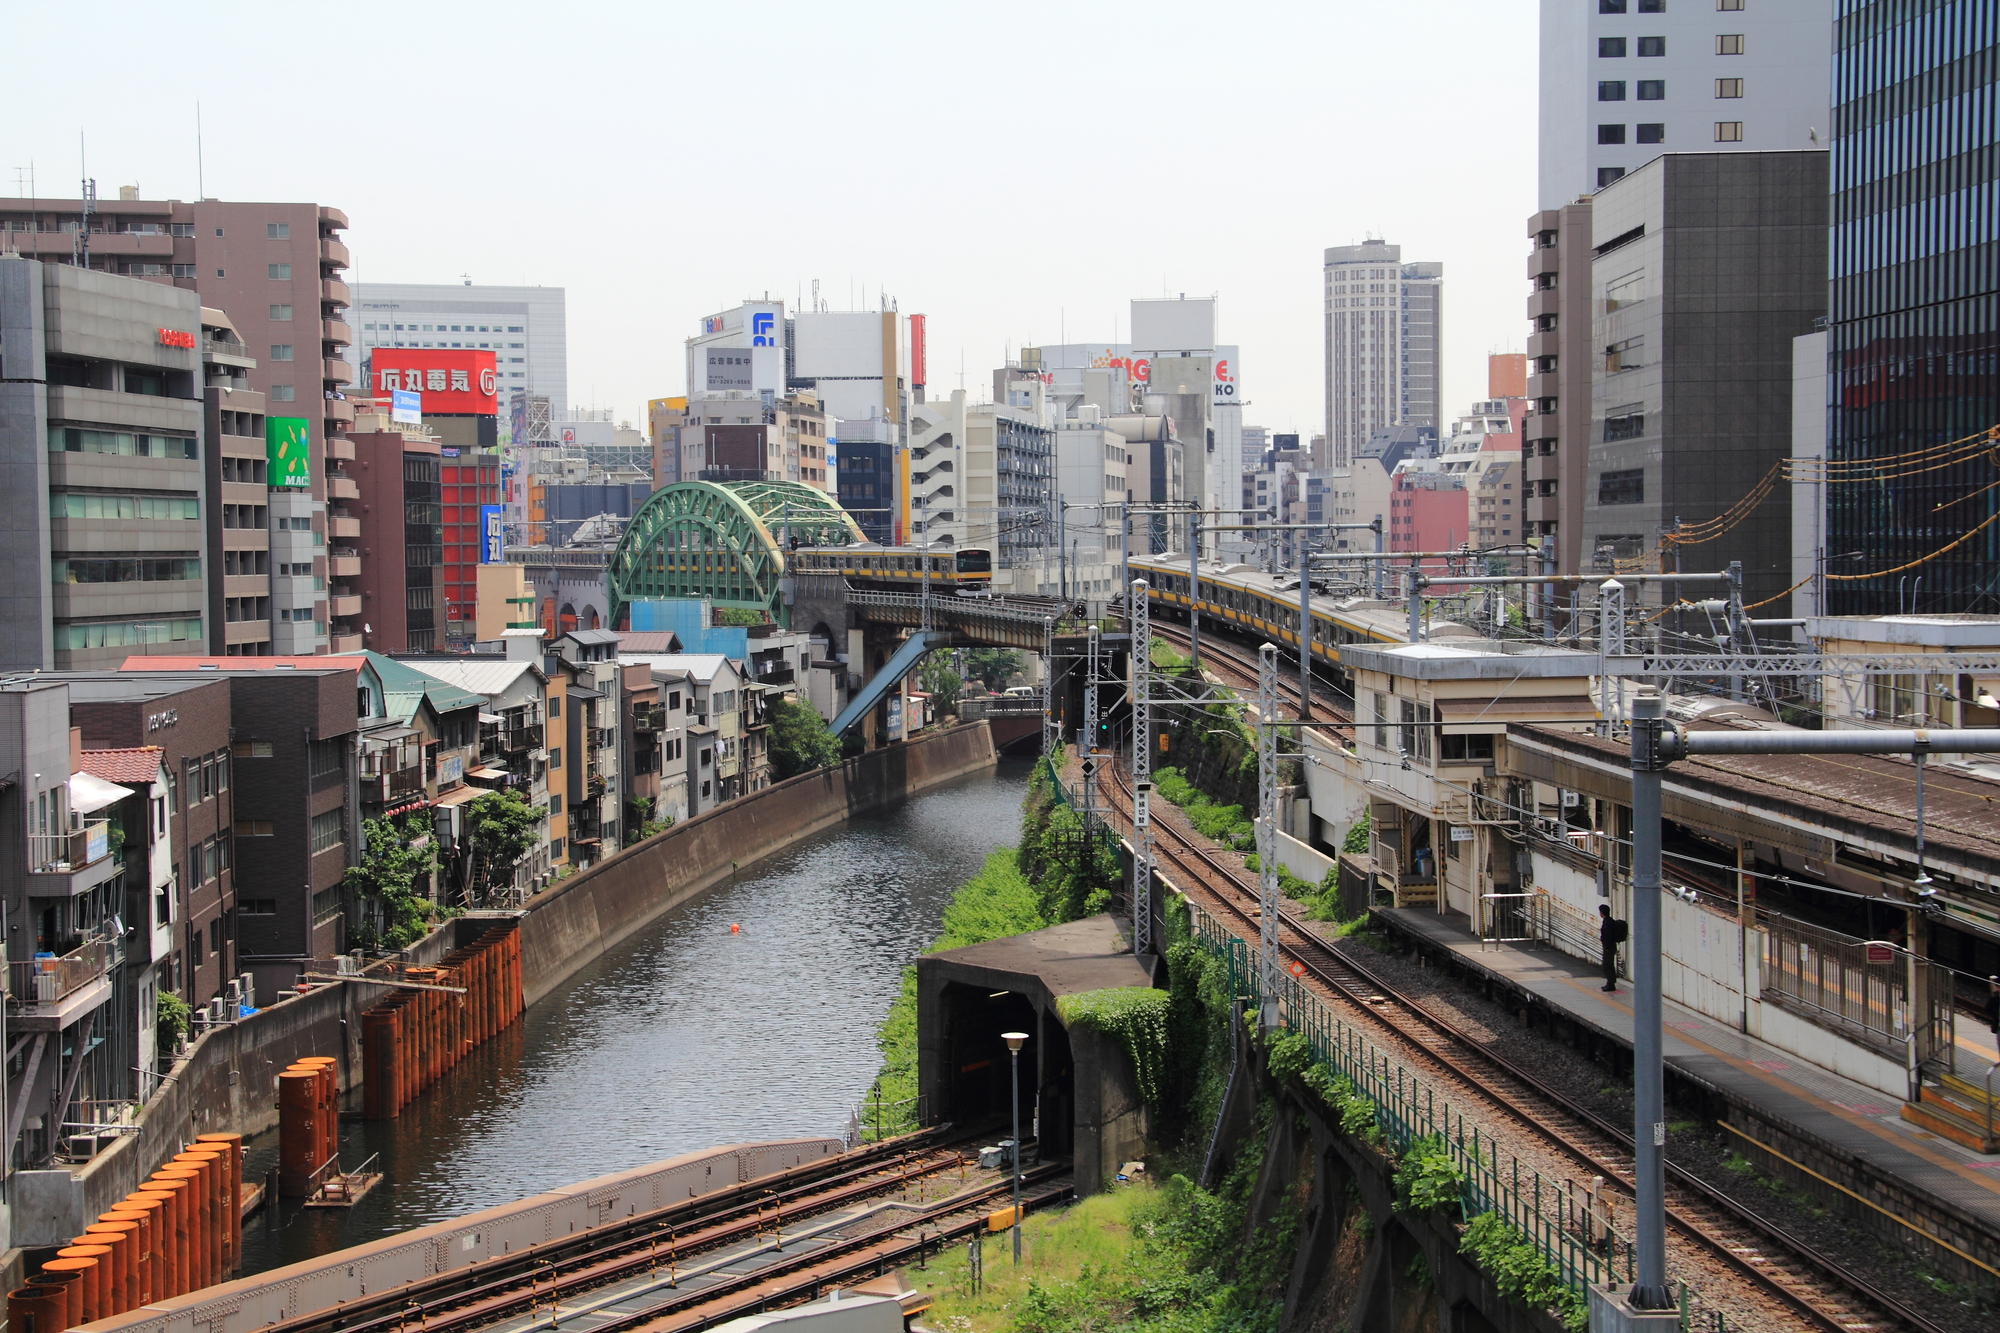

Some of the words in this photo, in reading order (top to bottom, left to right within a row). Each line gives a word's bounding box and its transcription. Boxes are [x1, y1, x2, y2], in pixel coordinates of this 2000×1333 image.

[158, 328, 196, 348] TOSHIBA
[709, 357, 751, 366] 広告募集中
[380, 368, 470, 392] 石丸電気
[487, 512, 501, 561] 石丸
